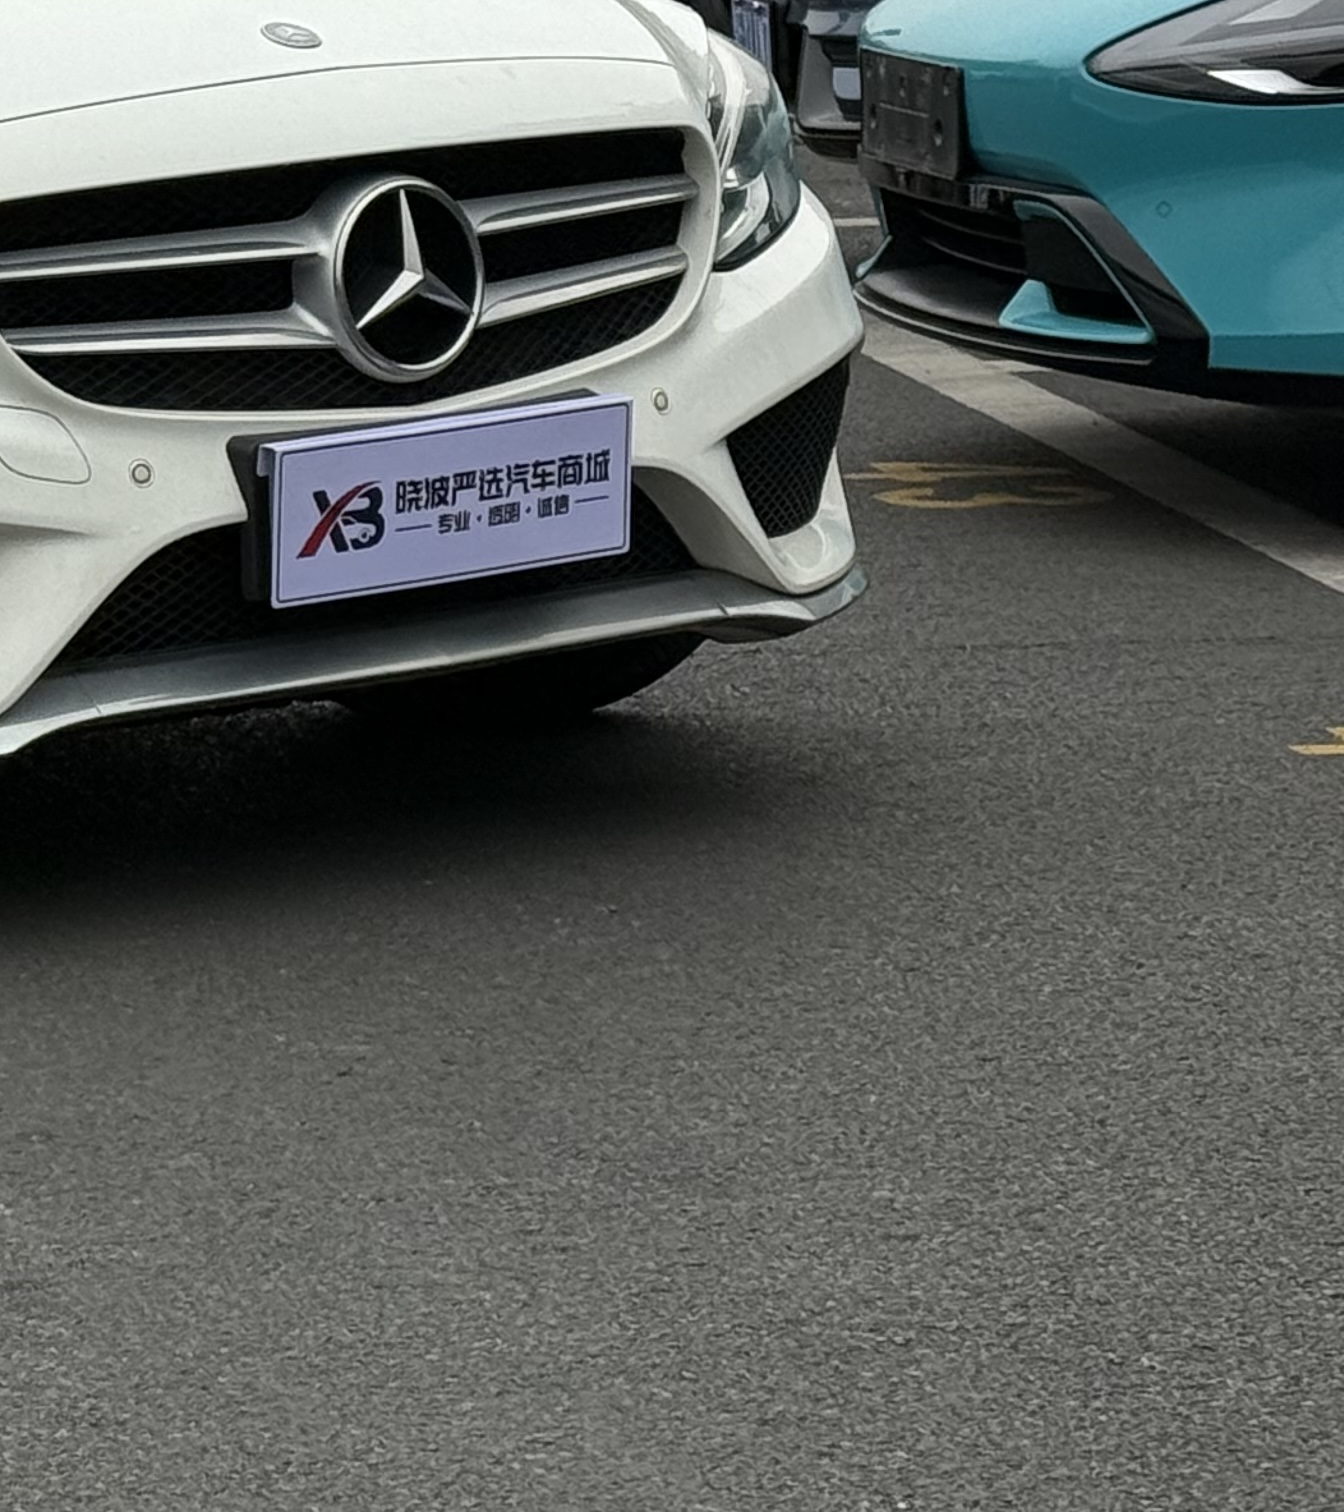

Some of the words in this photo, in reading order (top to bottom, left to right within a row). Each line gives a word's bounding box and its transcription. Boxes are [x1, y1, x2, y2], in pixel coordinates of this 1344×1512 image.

[394, 448, 611, 516] 晓波严选汽车商城
